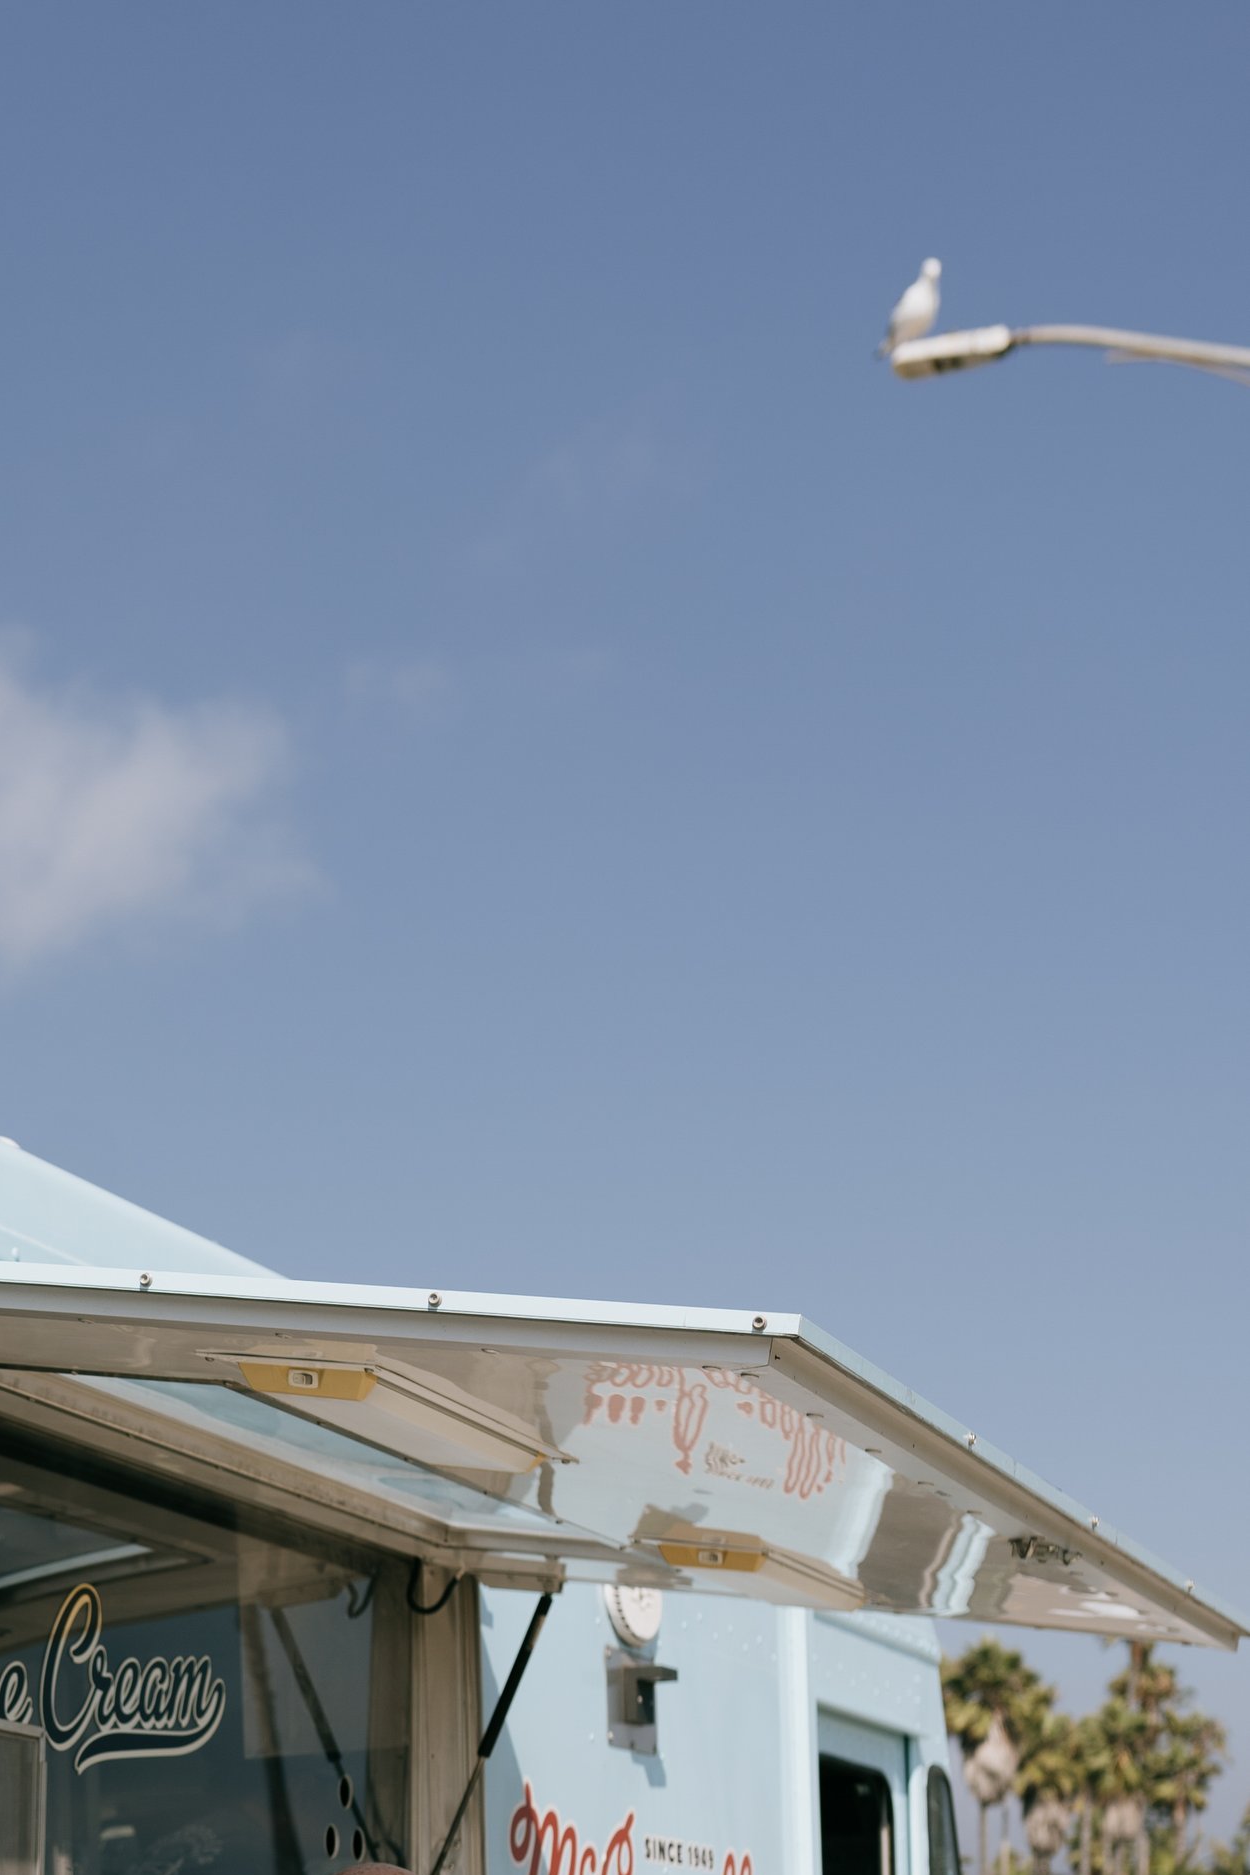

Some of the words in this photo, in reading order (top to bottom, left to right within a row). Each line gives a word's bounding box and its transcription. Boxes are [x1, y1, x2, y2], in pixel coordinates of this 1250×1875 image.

[40, 1583, 226, 1775] Cream
[645, 1838, 683, 1864] SINCE
[688, 1846, 714, 1870] 1949
